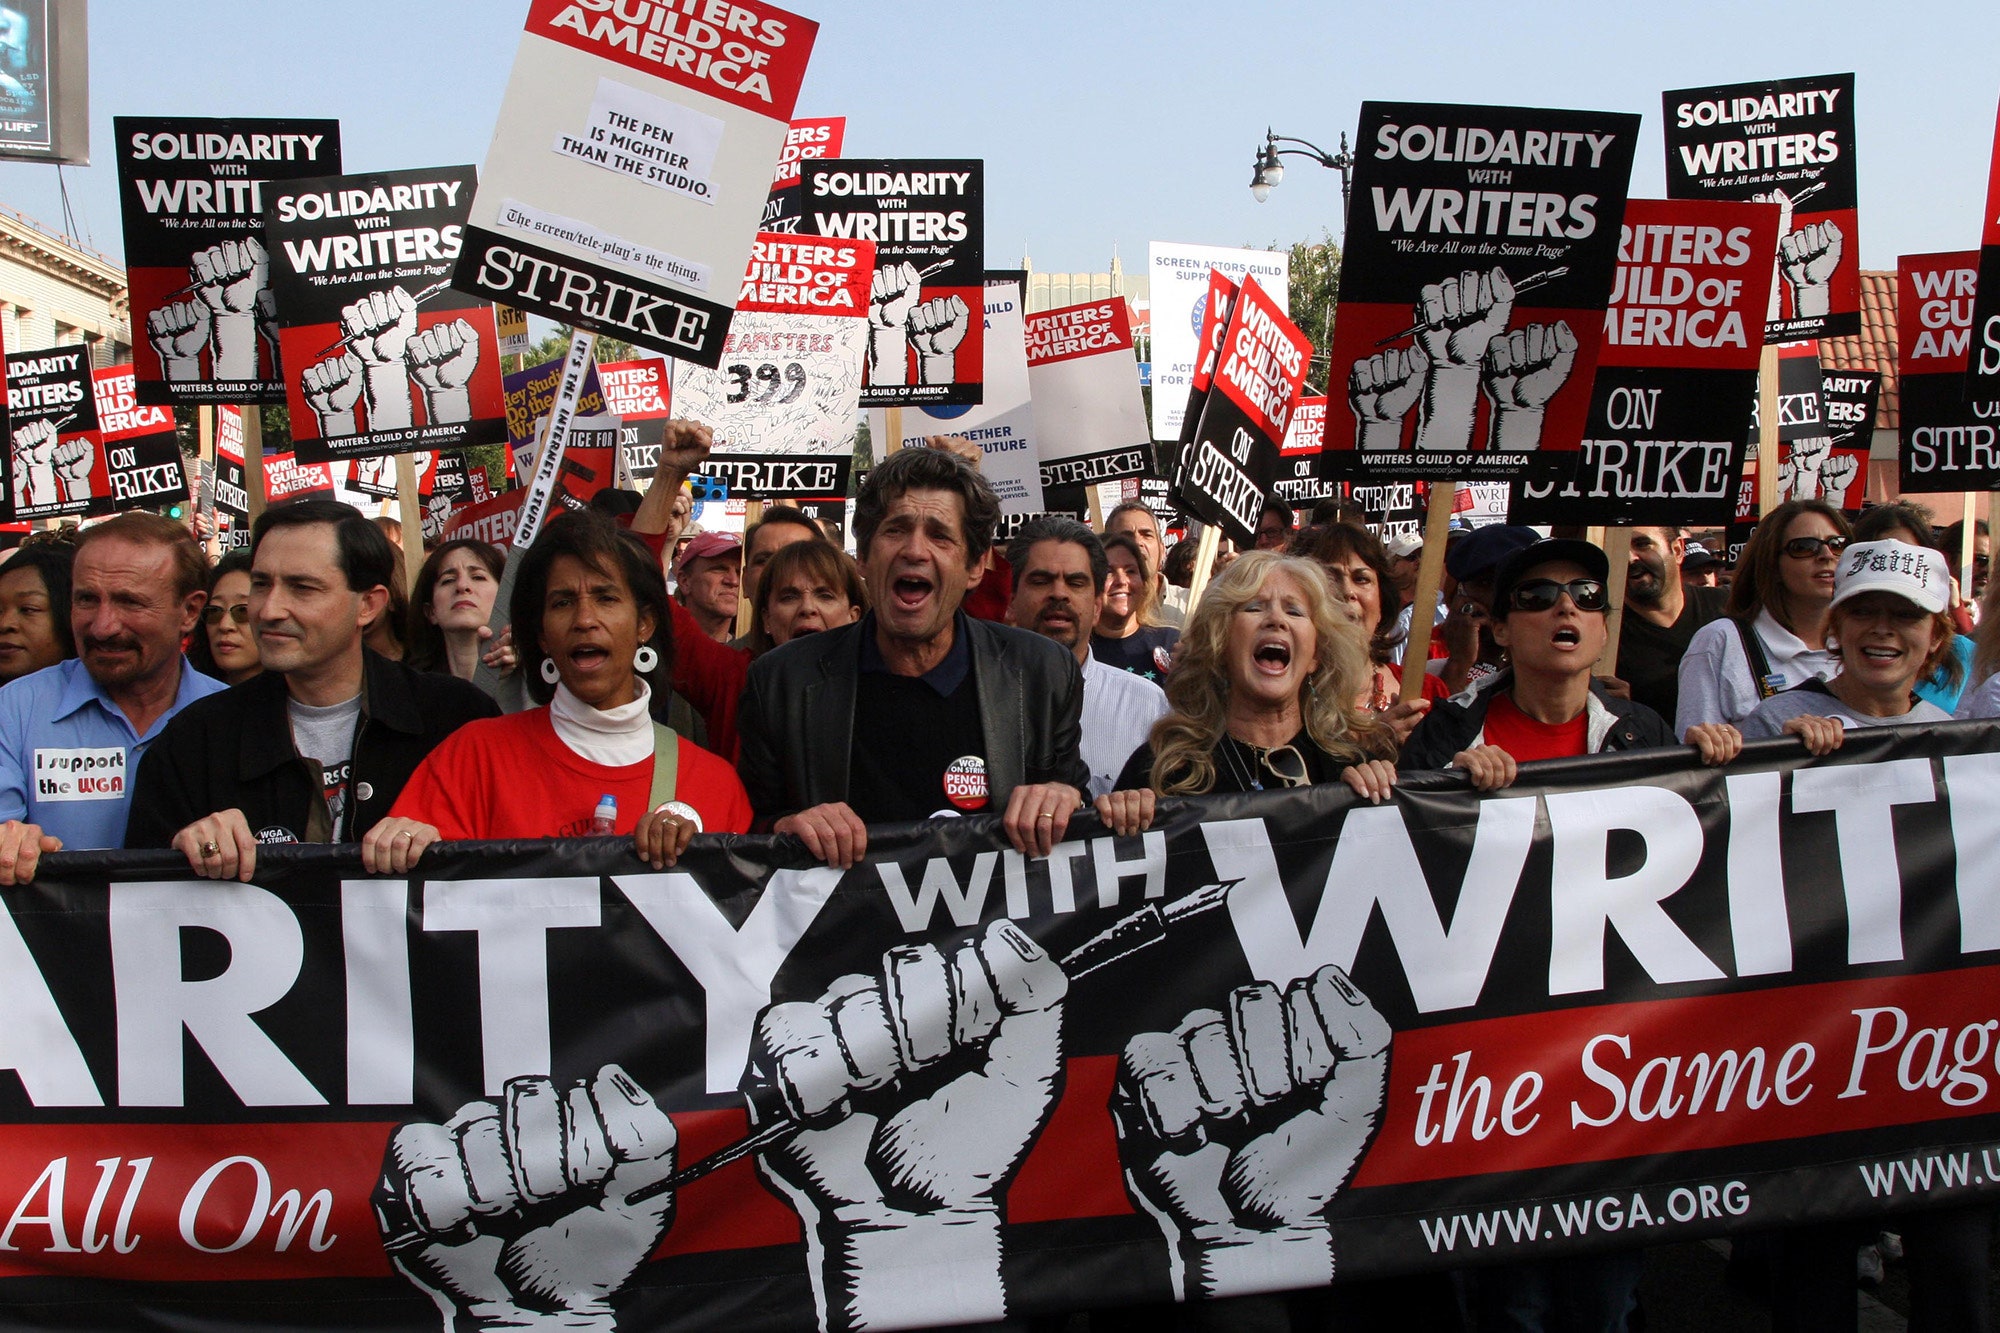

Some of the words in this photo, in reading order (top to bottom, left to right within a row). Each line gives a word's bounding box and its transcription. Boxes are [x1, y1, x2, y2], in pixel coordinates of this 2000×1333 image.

[549, 4, 774, 103] AMERICA
[722, 41, 771, 70] OF
[1677, 88, 1841, 128] SOLIDARITY
[608, 111, 639, 132] THE
[642, 123, 674, 144] PEN
[1744, 122, 1776, 135] WITH
[131, 132, 324, 161] SOLIDARITY
[590, 126, 606, 142] IS
[609, 133, 689, 171] MIGHTIER
[1374, 123, 1616, 168] SOLIDARITY
[1679, 130, 1839, 177] WRITERS
[210, 164, 248, 176] WITH
[562, 137, 608, 163] THAN
[614, 154, 645, 176] THE
[647, 166, 711, 199] STUDIO.
[1467, 168, 1512, 185] WITH
[1717, 177, 1733, 187] Are
[1734, 175, 1748, 185] All
[1761, 173, 1774, 182] the
[1776, 171, 1799, 181] Same
[136, 179, 263, 214] WRIT
[813, 172, 971, 196] SOLIDARITY
[277, 181, 462, 223] SOLIDARITY
[876, 198, 907, 209] WITH
[1371, 186, 1599, 239] WRITERS
[181, 218, 199, 229] Are
[200, 218, 215, 229] All
[217, 220, 230, 229] on
[231, 218, 247, 229] the
[248, 218, 265, 229] Sa
[354, 216, 391, 230] WITH
[814, 211, 968, 242] WRITERS
[283, 224, 464, 274] WRITERS
[506, 208, 532, 228] The
[645, 254, 664, 270] the
[667, 261, 701, 283] thing.
[749, 241, 857, 268] RITERS
[892, 245, 904, 255] the
[905, 245, 929, 255] Same
[1415, 240, 1438, 253] Are
[1440, 240, 1460, 254] All
[1461, 246, 1476, 254] on
[1477, 242, 1496, 255] the
[1499, 242, 1532, 256] Same
[1617, 223, 1752, 267] RITERS
[329, 274, 347, 284] Are
[348, 272, 363, 283] All
[364, 273, 377, 281] on
[378, 269, 393, 279] the
[394, 267, 422, 278] Same
[813, 270, 849, 287] OF
[1155, 256, 1200, 269] SCREEN
[1203, 261, 1246, 272] ACTORS
[1249, 264, 1282, 276] GUILD
[476, 245, 711, 351] STRIKE
[1696, 278, 1743, 307] OF
[983, 302, 1014, 315] UILD
[1087, 322, 1111, 335] OF
[1241, 294, 1303, 378] WRITERS
[1773, 323, 1785, 332] OF
[1786, 318, 1825, 331] AMERICA
[571, 339, 587, 370] IT'S
[722, 333, 835, 353] EAMSTERS
[1025, 330, 1121, 361] MERICA
[601, 367, 659, 386] RITERS
[1236, 327, 1280, 388] GUILD
[1277, 376, 1294, 402] OF
[18, 377, 40, 386] WITH
[170, 383, 213, 392] WRITERS
[216, 383, 247, 392] GUILD
[249, 383, 264, 392] OF
[562, 374, 578, 402] THE
[641, 386, 659, 397] OF
[727, 362, 807, 404] 399
[871, 387, 897, 396] GUILD
[900, 387, 910, 396] OF
[912, 386, 949, 396] AMERICA
[1161, 375, 1184, 385] FOR
[1222, 352, 1288, 434] AMERICA
[1822, 377, 1873, 394] ARITY
[8, 380, 84, 409] RITERS
[507, 406, 528, 427] Do
[527, 393, 553, 417] the
[1606, 387, 1662, 430] ON
[327, 436, 369, 449] WRITERS
[372, 433, 402, 443] GUILD
[405, 431, 419, 440] OF
[422, 425, 467, 437] AMERICA
[537, 408, 570, 481] INTERNET,
[597, 432, 613, 448] FOR
[1231, 426, 1255, 466] ON
[1911, 425, 2000, 473] STR
[110, 446, 137, 469] ON
[264, 457, 298, 474] WRIT
[1040, 450, 1144, 488] STRIKE
[1294, 461, 1311, 477] ON
[1361, 454, 1412, 465] WRITERS
[1415, 454, 1452, 465] GUILD
[1456, 454, 1473, 465] OF
[1475, 454, 1529, 465] AMERICA
[110, 462, 183, 501] RIKE
[229, 467, 239, 484] ON
[270, 466, 309, 485] GUILD
[308, 466, 322, 476] OF
[270, 475, 329, 497] AMERICA
[432, 473, 465, 488] TERS
[698, 461, 838, 491] TRIKE
[1191, 440, 1265, 535] STRIKE
[53, 502, 62, 510] OF
[63, 500, 90, 509] AMERICA
[517, 487, 545, 545] STUPID.
[1846, 548, 1931, 589] Faith
[37, 754, 43, 769] I
[49, 752, 124, 773] support
[959, 759, 981, 767] WGA
[39, 779, 72, 794] the
[77, 776, 123, 794] WGA
[260, 829, 283, 839] WGA
[266, 835, 292, 845] STRIKE
[875, 830, 1167, 933] WITH
[1199, 750, 2000, 1015] WRIT
[1, 1155, 143, 1255] All
[178, 1154, 338, 1255] On
[1413, 1050, 1545, 1148] the
[1568, 1033, 1817, 1131] Same
[1836, 1005, 2000, 1107] Pag
[1418, 1179, 1751, 1254] WWW.WGA.ORG
